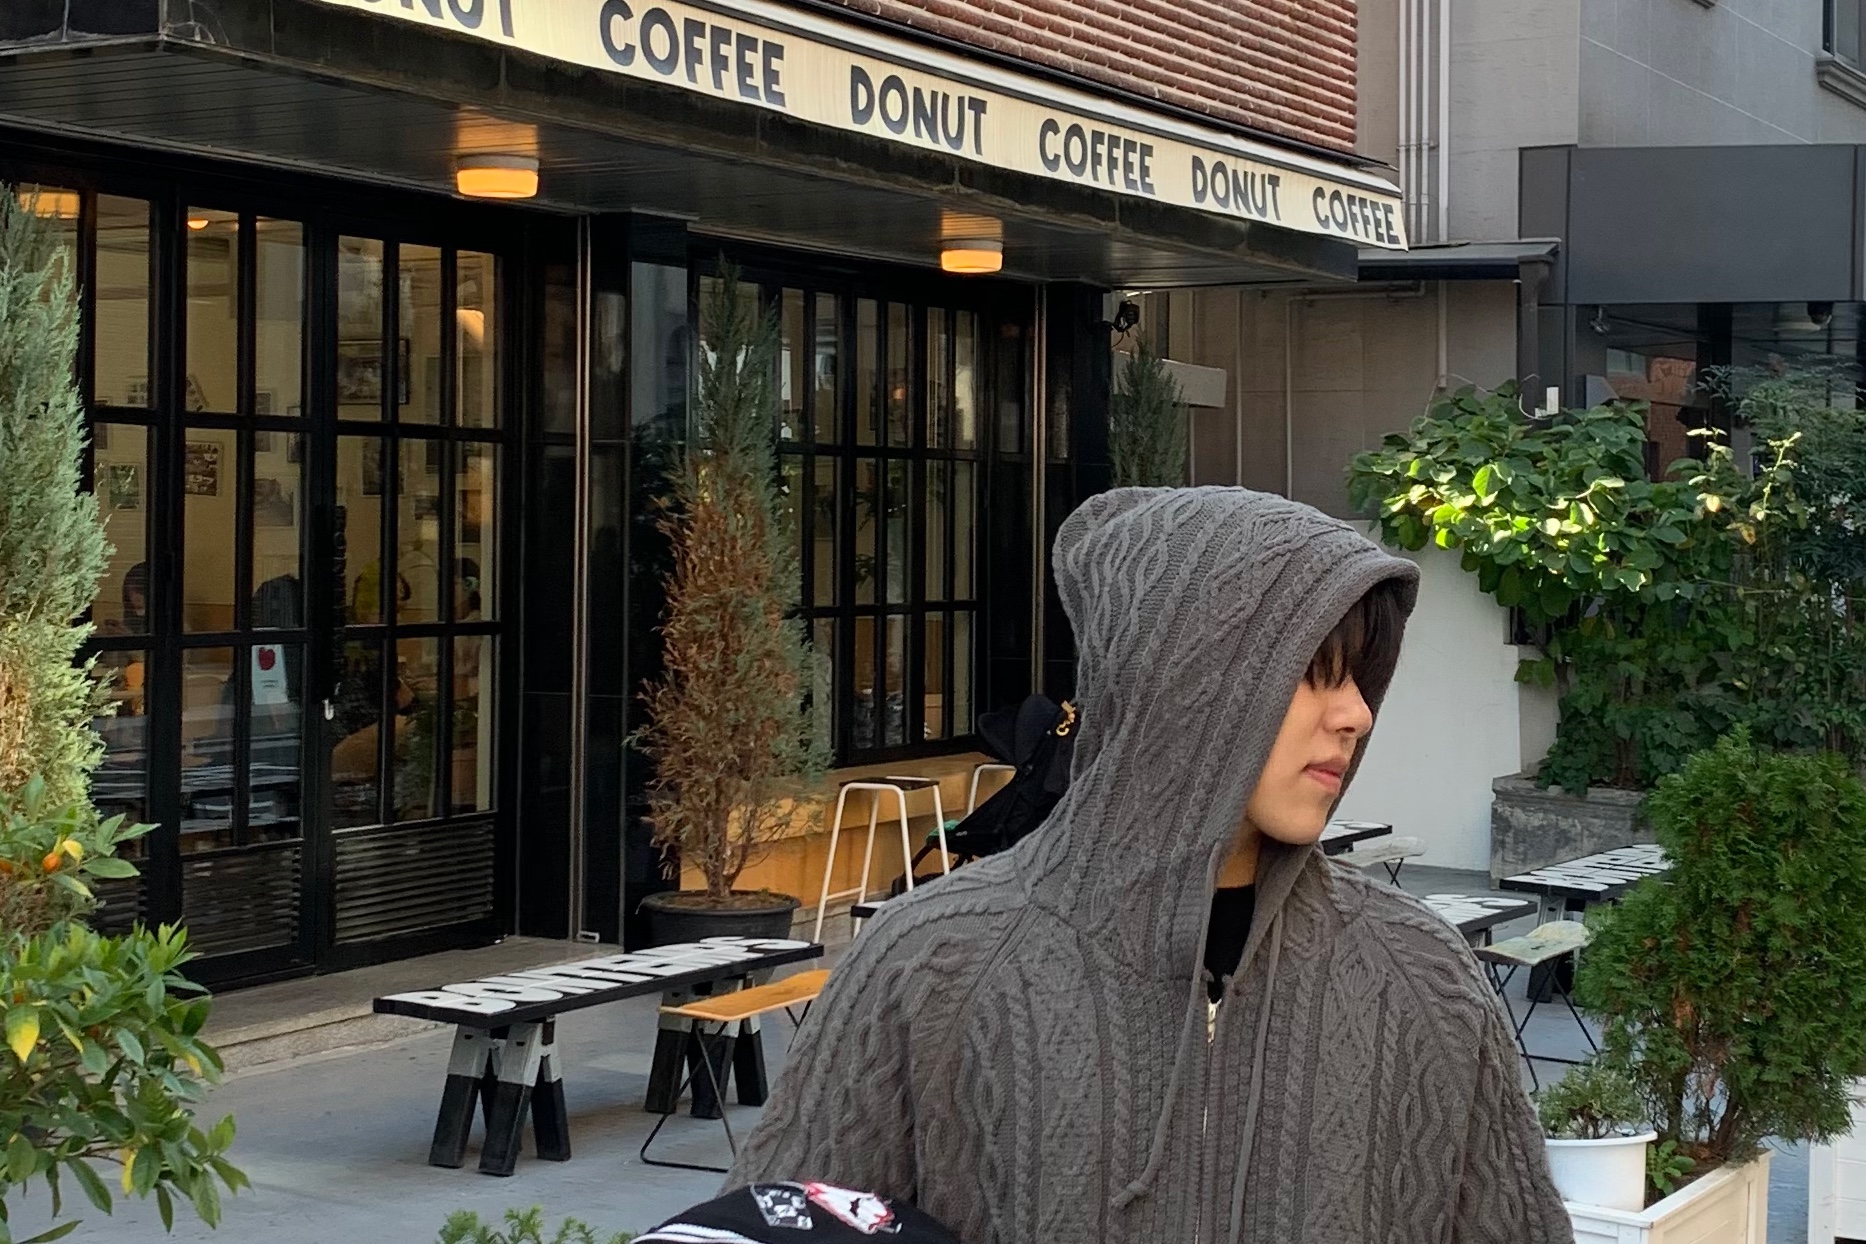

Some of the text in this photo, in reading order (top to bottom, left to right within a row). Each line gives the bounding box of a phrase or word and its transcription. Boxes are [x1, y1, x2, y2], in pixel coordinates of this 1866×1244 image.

[600, 0, 786, 107] COFFEE
[850, 64, 988, 156] DONUT
[1039, 117, 1156, 195] COFFEE
[1191, 154, 1282, 221] DONUT
[1312, 186, 1401, 245] COFFEE
